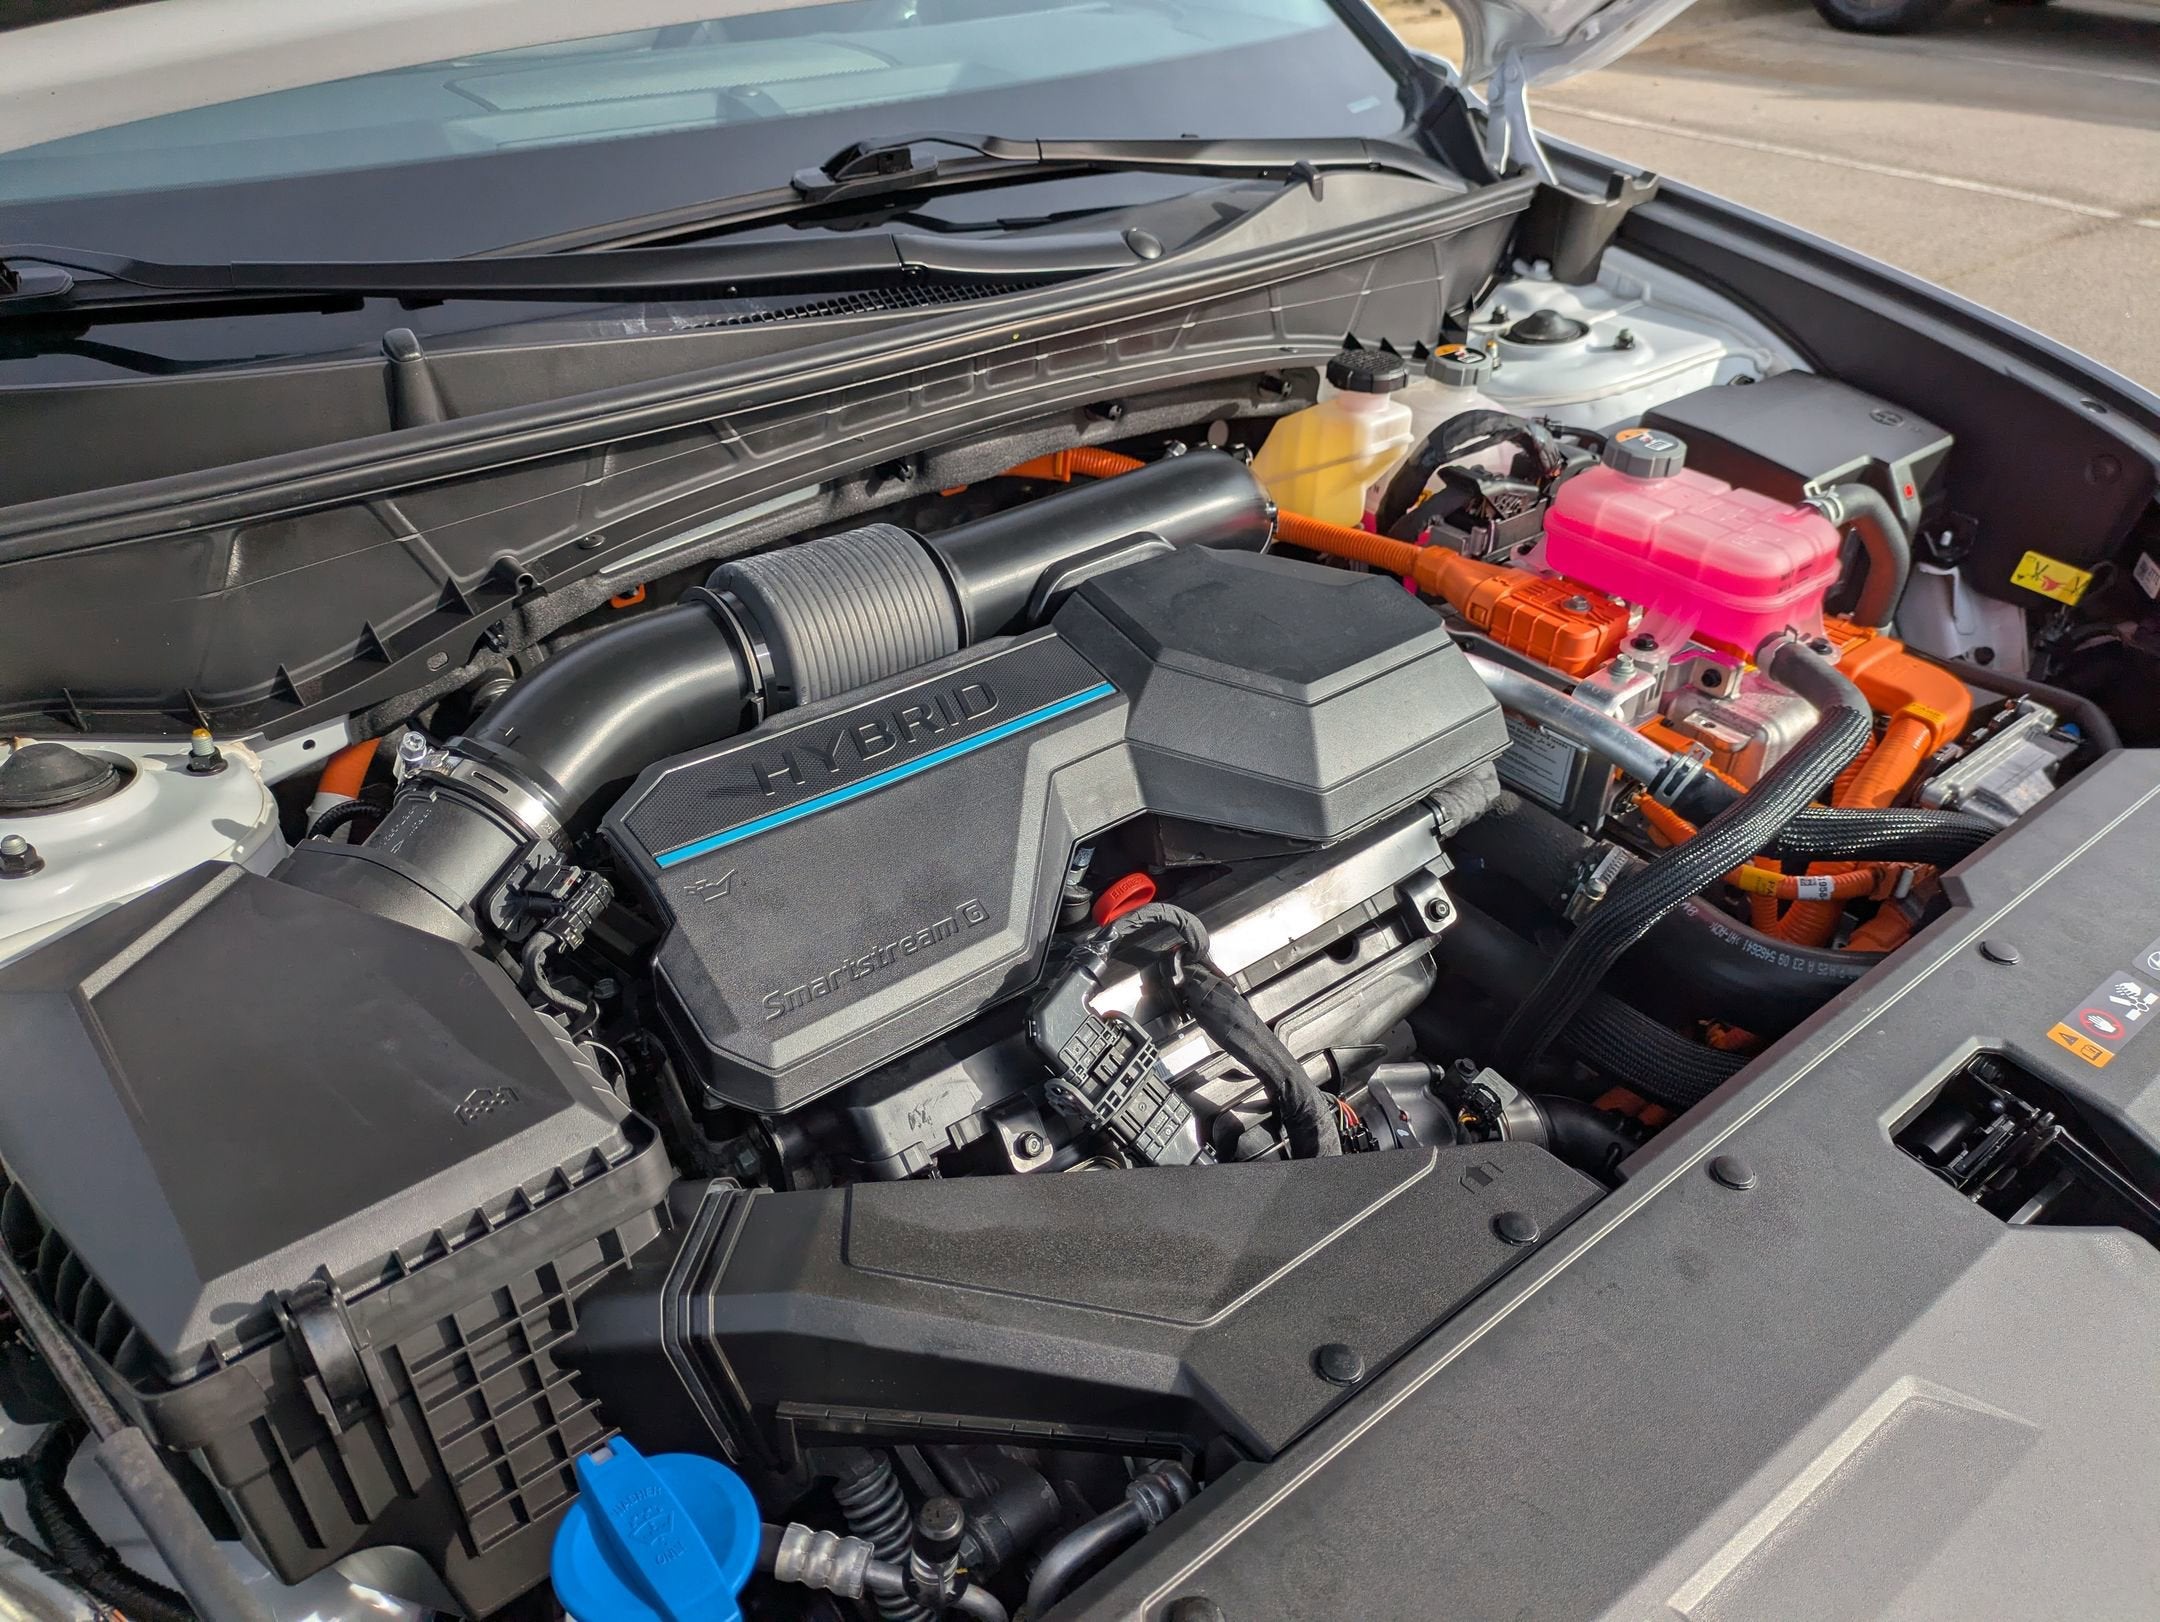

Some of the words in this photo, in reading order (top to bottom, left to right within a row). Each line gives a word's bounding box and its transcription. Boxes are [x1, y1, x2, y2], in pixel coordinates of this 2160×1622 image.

[753, 679, 1000, 797] HYBRID
[761, 916, 961, 1021] Smartstream
[956, 898, 991, 928] G
